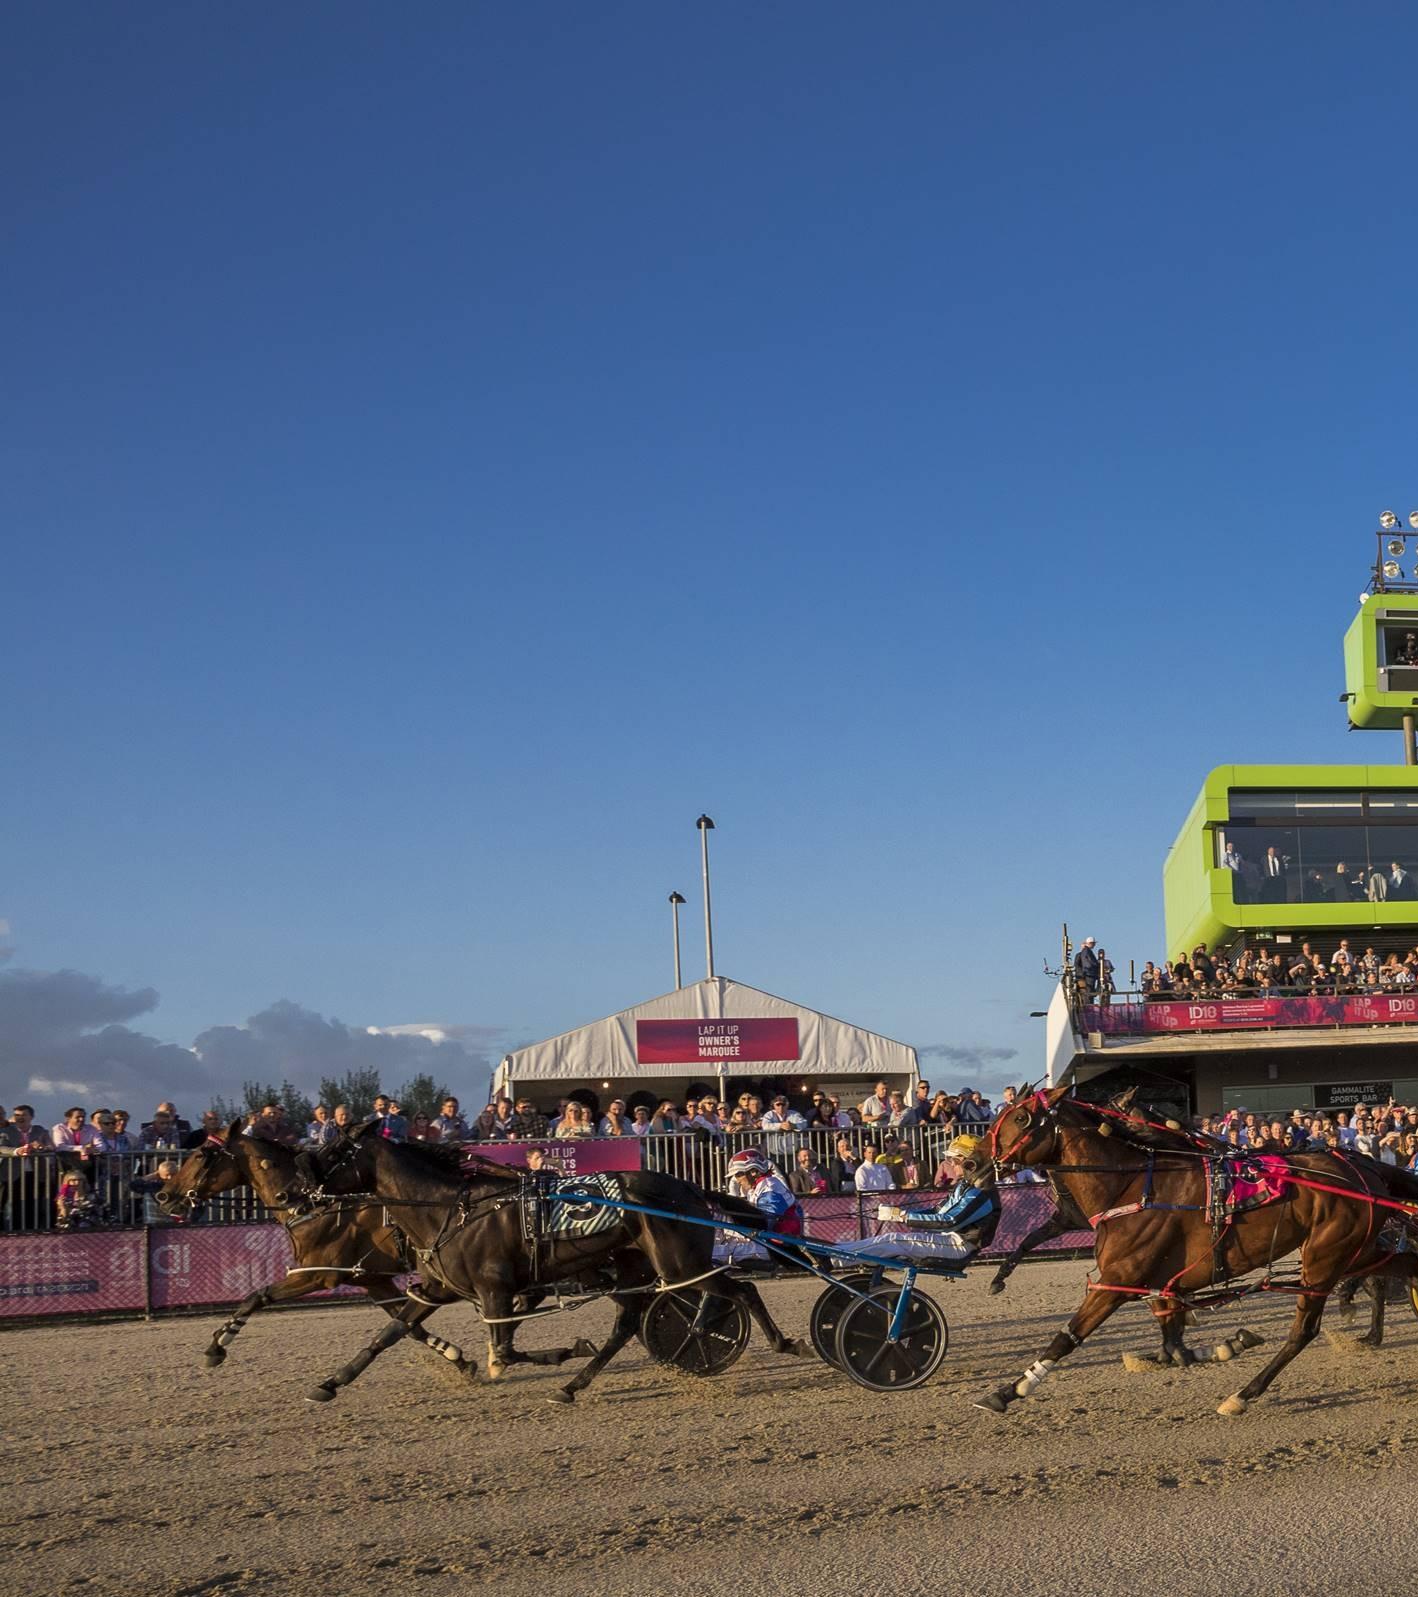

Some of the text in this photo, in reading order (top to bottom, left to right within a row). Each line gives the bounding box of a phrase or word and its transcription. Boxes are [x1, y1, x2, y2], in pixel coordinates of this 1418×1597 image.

[1152, 1005, 1170, 1015] LAP
[1388, 999, 1415, 1012] ID18
[1188, 1006, 1217, 1019] ID18
[1162, 1016, 1178, 1028] UP
[698, 1025, 739, 1036] LAP IT UP
[698, 1036, 740, 1046] OWNER'S
[698, 1046, 740, 1057] MARQUEE
[1331, 1086, 1375, 1095] GAMMALITE
[1330, 1094, 1378, 1103] SPORTS BAR
[562, 1148, 576, 1157] UP
